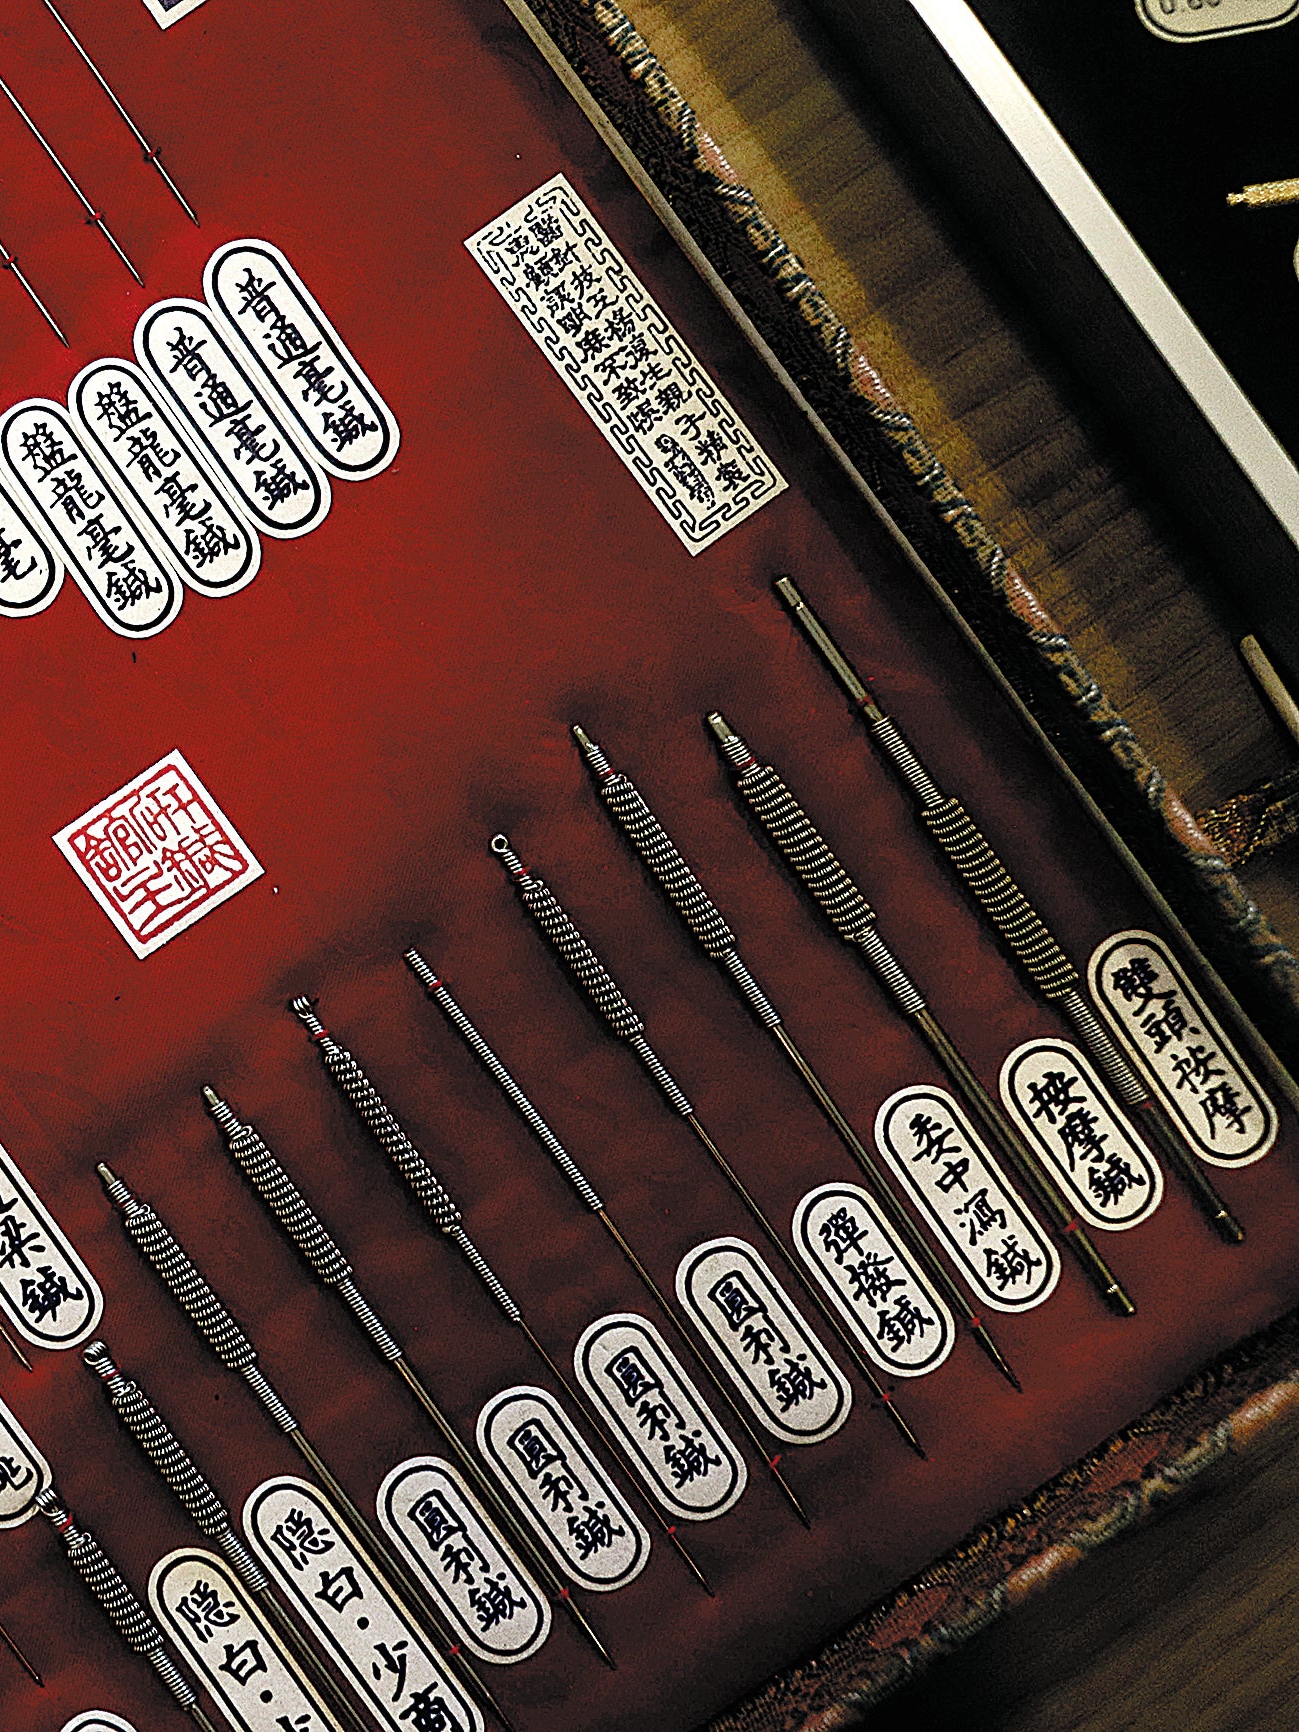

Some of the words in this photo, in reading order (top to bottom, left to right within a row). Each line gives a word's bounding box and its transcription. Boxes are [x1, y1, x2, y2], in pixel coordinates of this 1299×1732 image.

[166, 327, 310, 510] 普通毫鍼
[235, 268, 378, 452] 普通毫鍼
[1027, 1072, 1146, 1208] 按摩鍼
[1111, 958, 1253, 1140] 雙頭按摩
